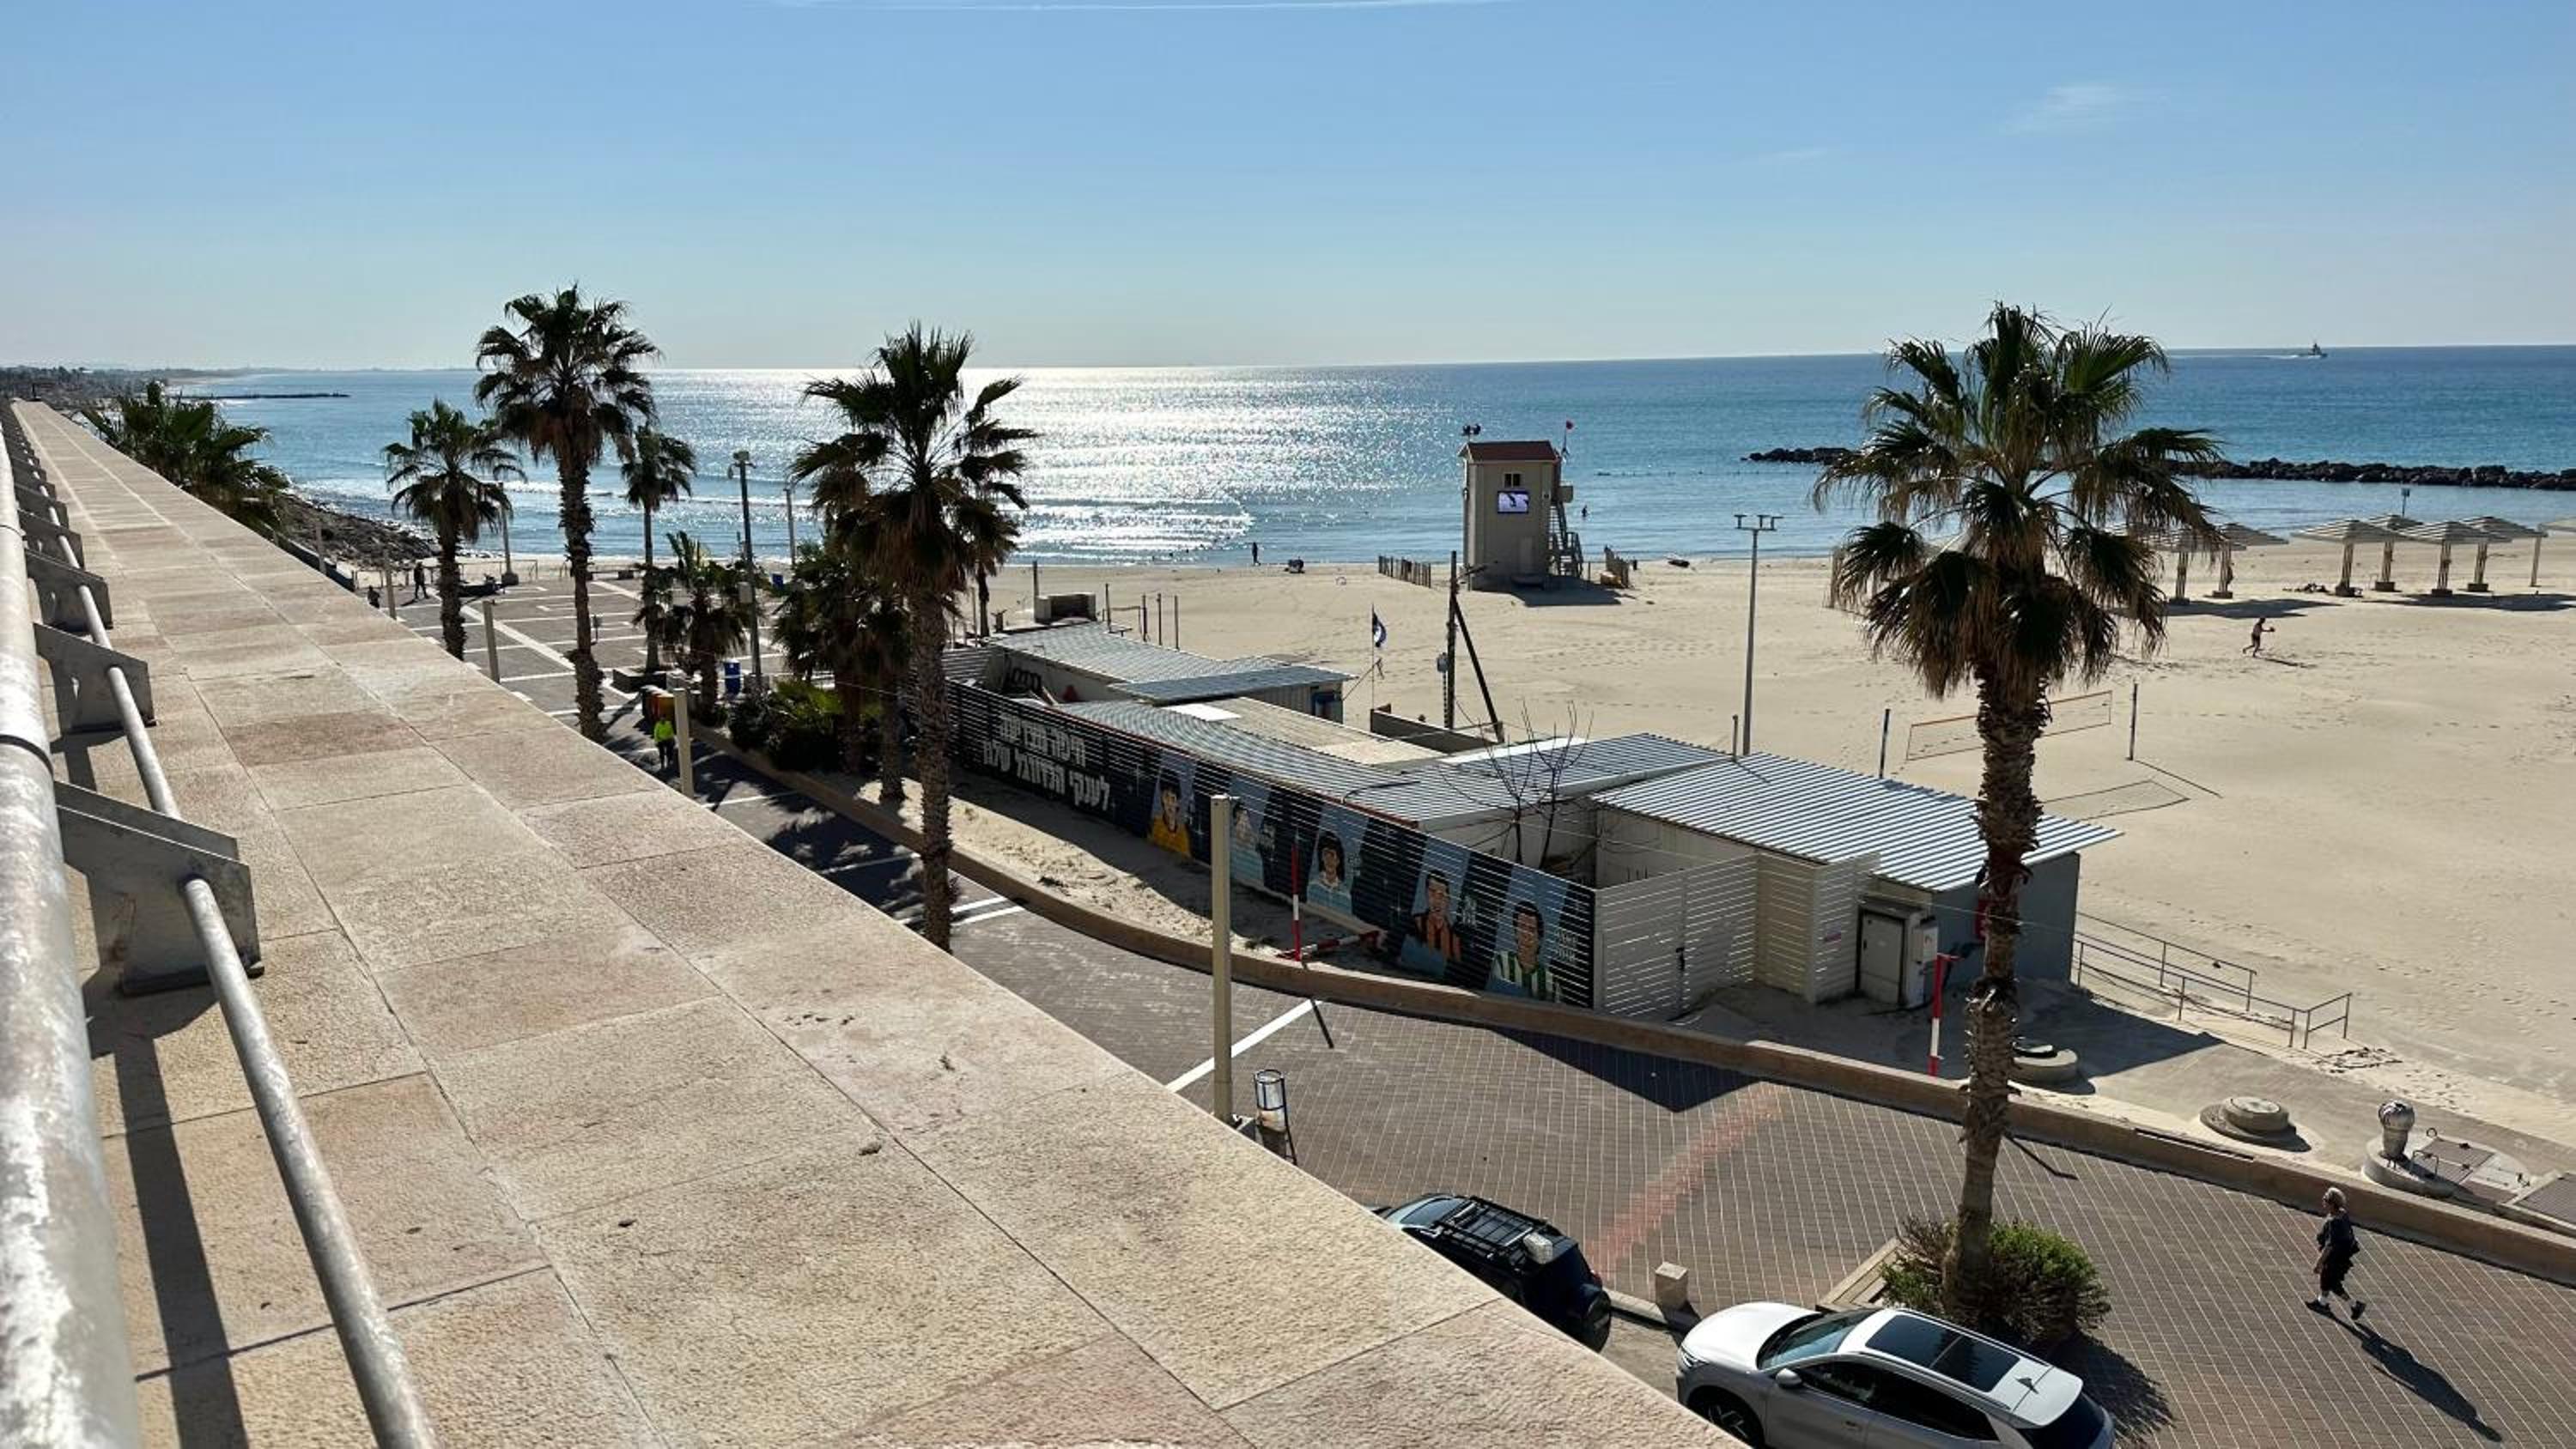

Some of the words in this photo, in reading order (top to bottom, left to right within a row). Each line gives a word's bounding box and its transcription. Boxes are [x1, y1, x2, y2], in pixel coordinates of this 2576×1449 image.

[982, 739, 1011, 772] שלה
[1050, 727, 1086, 768] חיפה
[1069, 770, 1111, 811] לענקי
